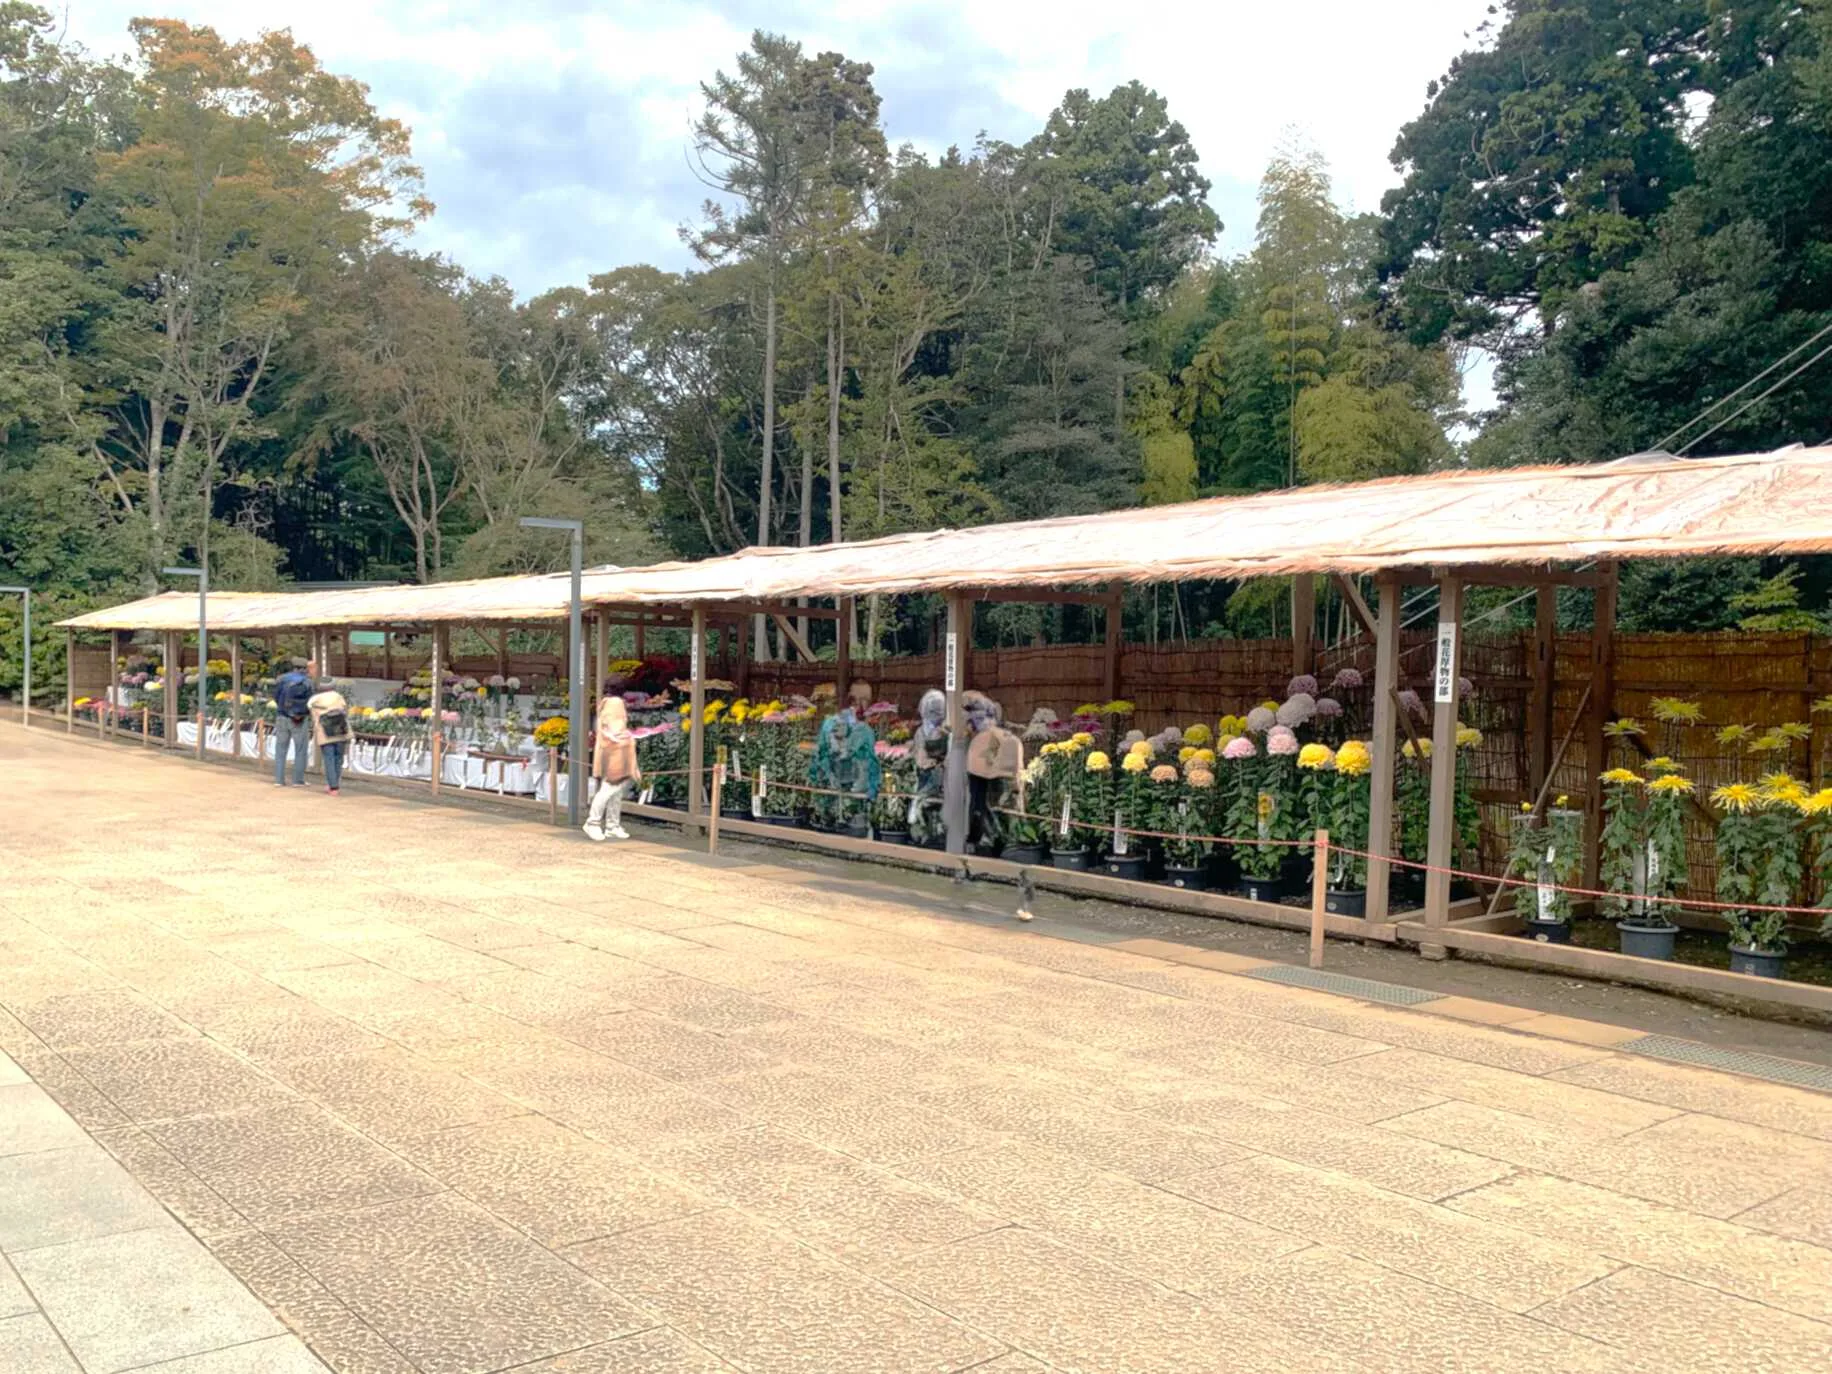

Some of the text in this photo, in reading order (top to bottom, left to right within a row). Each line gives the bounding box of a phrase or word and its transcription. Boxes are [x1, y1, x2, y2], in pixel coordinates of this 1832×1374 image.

[1439, 631, 1452, 696] 一般花厚物の部
